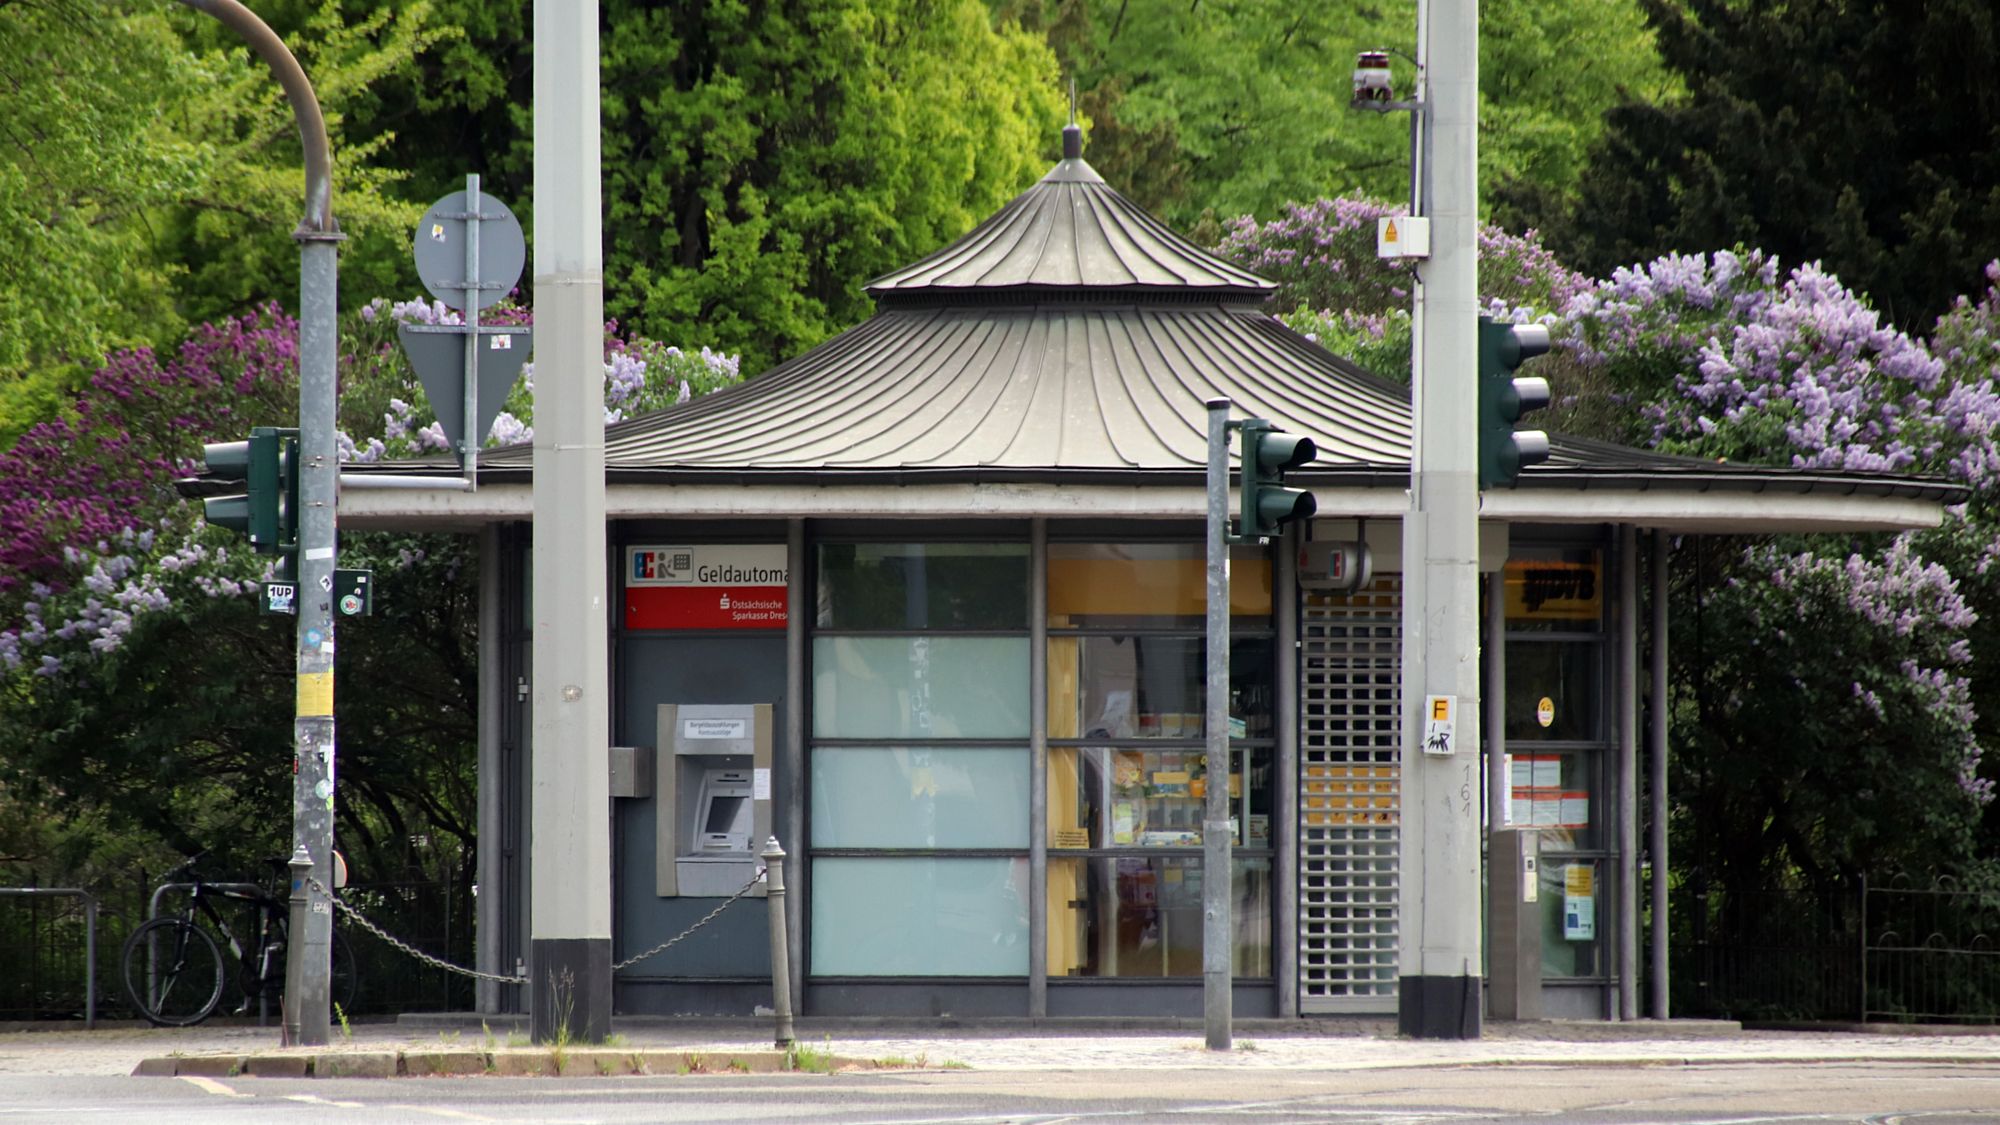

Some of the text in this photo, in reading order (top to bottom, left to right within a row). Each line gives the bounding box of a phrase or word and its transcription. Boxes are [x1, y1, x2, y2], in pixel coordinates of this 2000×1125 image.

[269, 586, 292, 598] 1UP
[731, 600, 783, 610] Ostsächsische
[732, 610, 769, 622] Sparkasse
[1433, 699, 1448, 719] F
